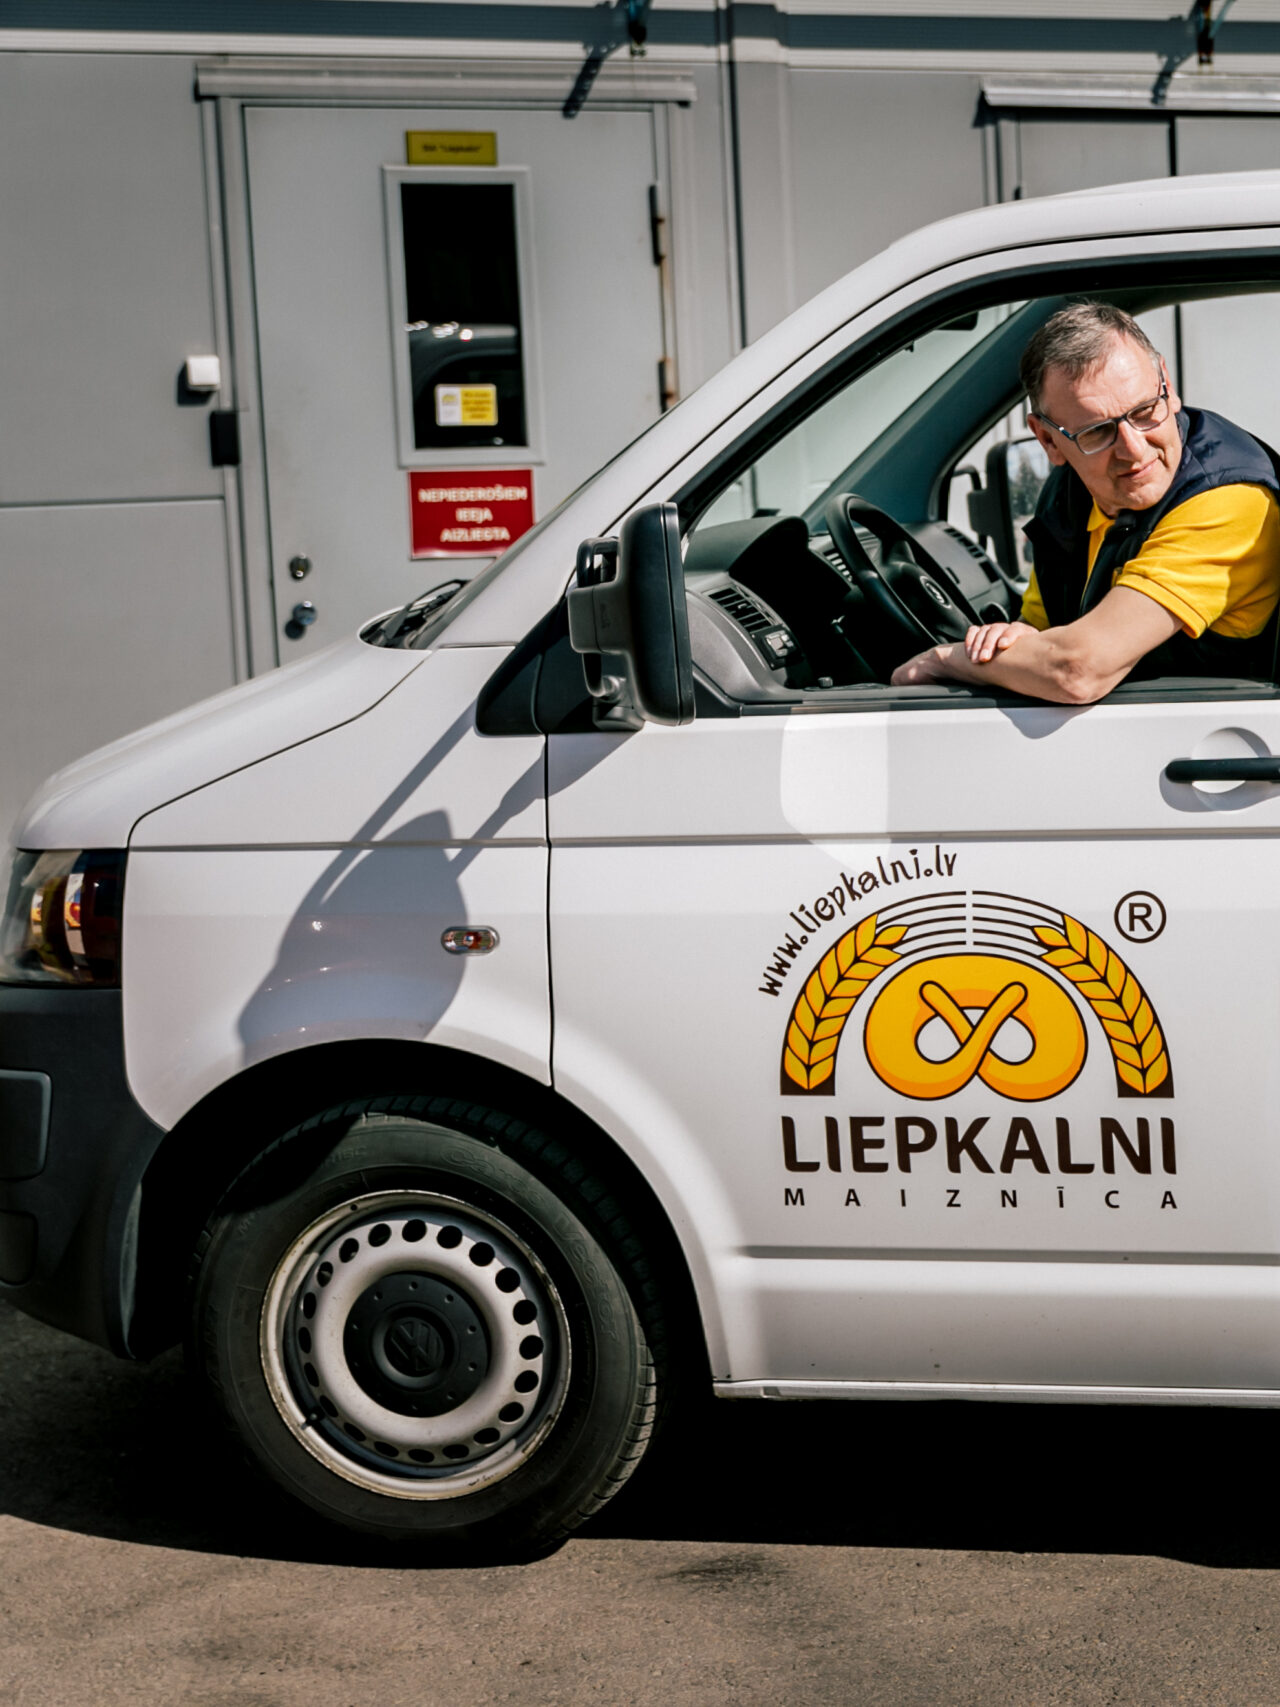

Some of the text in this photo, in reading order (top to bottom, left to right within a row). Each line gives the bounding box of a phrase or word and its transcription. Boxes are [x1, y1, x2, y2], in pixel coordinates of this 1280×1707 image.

[455, 507, 493, 524] IEEJA
[758, 845, 957, 997] www.liepkalni.lv
[781, 1115, 1177, 1175] LIEPKALNI
[784, 1186, 1178, 1209] MAIZNĪCA
